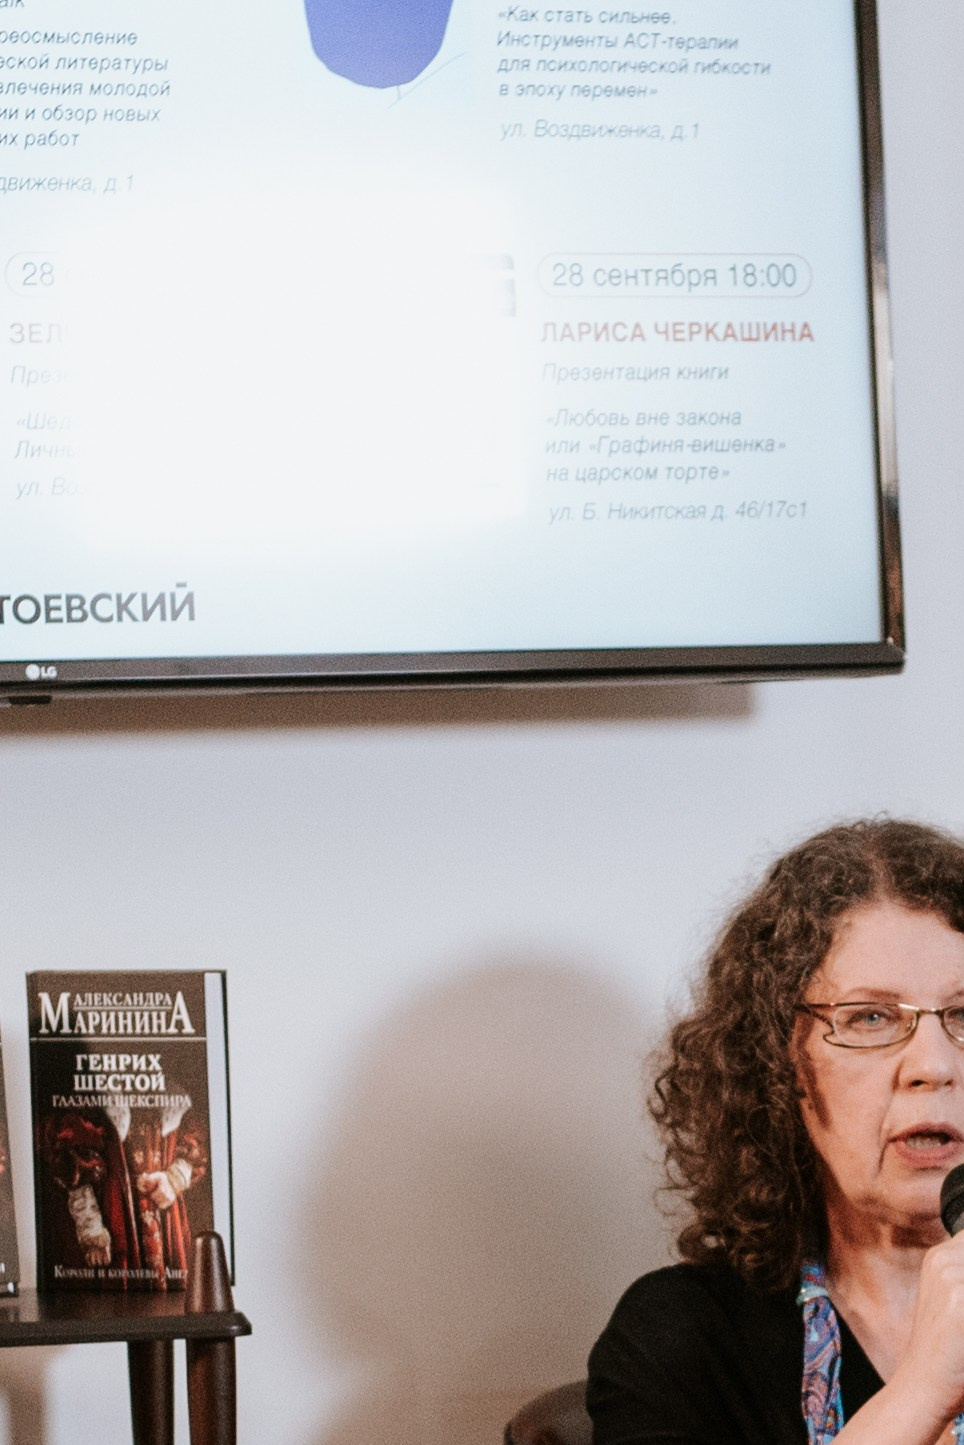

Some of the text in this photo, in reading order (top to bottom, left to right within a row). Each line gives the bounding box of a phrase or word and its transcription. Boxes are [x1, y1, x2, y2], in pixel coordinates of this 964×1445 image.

[544, 9, 593, 24] стать
[498, 31, 617, 51] Инструменты
[55, 56, 168, 75] литературы
[498, 58, 771, 75] для психологической гибкости
[89, 80, 170, 97] молодой
[499, 84, 510, 96] в
[515, 83, 566, 101] эпоху
[24, 107, 36, 120] и
[41, 104, 97, 125] обзор
[103, 107, 160, 123] новых
[24, 129, 79, 150] работ
[500, 123, 527, 141] ул.
[534, 119, 666, 141] Воздвиженка,
[22, 262, 55, 287] 28
[552, 262, 797, 292] 28 сентября 18:00
[541, 321, 815, 343] ЛАРИСА ЧЕРКАШИНА
[543, 363, 729, 385] Презентация книги
[636, 411, 670, 426] вне
[676, 411, 742, 426] закона
[545, 438, 580, 454] или
[547, 467, 569, 482] на
[575, 466, 658, 485] царском
[549, 506, 575, 526] ул.
[608, 502, 706, 521] Никитская
[40, 666, 58, 679] LG
[73, 992, 172, 1006] АЛЕКСАНДРА
[76, 1053, 163, 1072] ГЕНРИХ
[73, 1072, 166, 1092] ШЕСТОЙ
[52, 1094, 193, 1108] ГЛАЗАМИ ШЕКСПИРА
